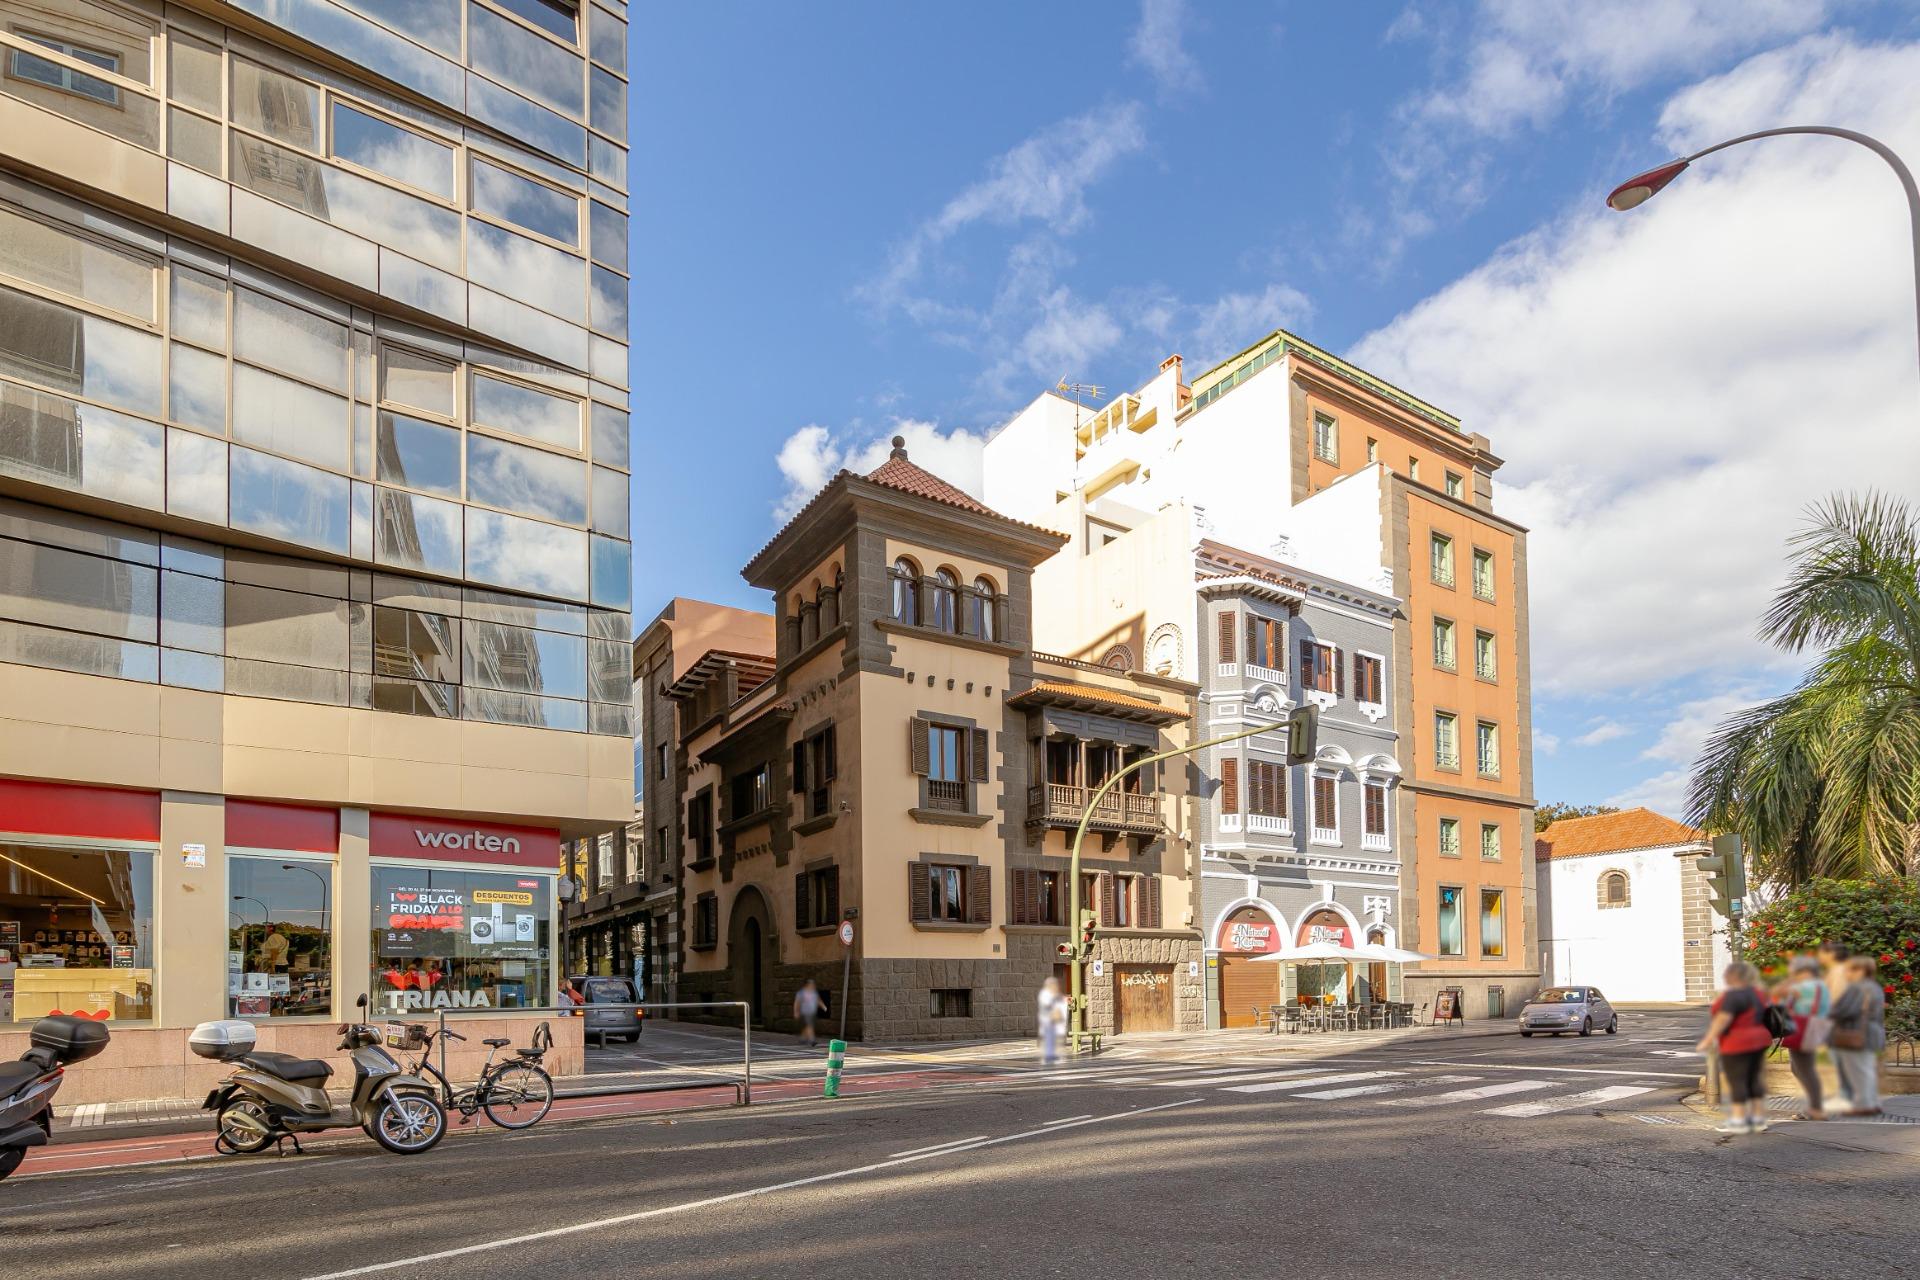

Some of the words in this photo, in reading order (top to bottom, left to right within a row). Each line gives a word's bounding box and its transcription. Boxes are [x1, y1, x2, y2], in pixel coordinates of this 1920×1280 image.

[415, 830, 520, 853] worten
[390, 892, 395, 902] I
[419, 894, 463, 905] BLACK
[476, 892, 530, 900] DESCUENTOS
[390, 903, 439, 914] FRIDAY
[1236, 924, 1268, 936] Natural
[1313, 926, 1344, 938] Natural
[1233, 935, 1265, 949] Kitchen
[384, 990, 490, 1009] TRIANA
